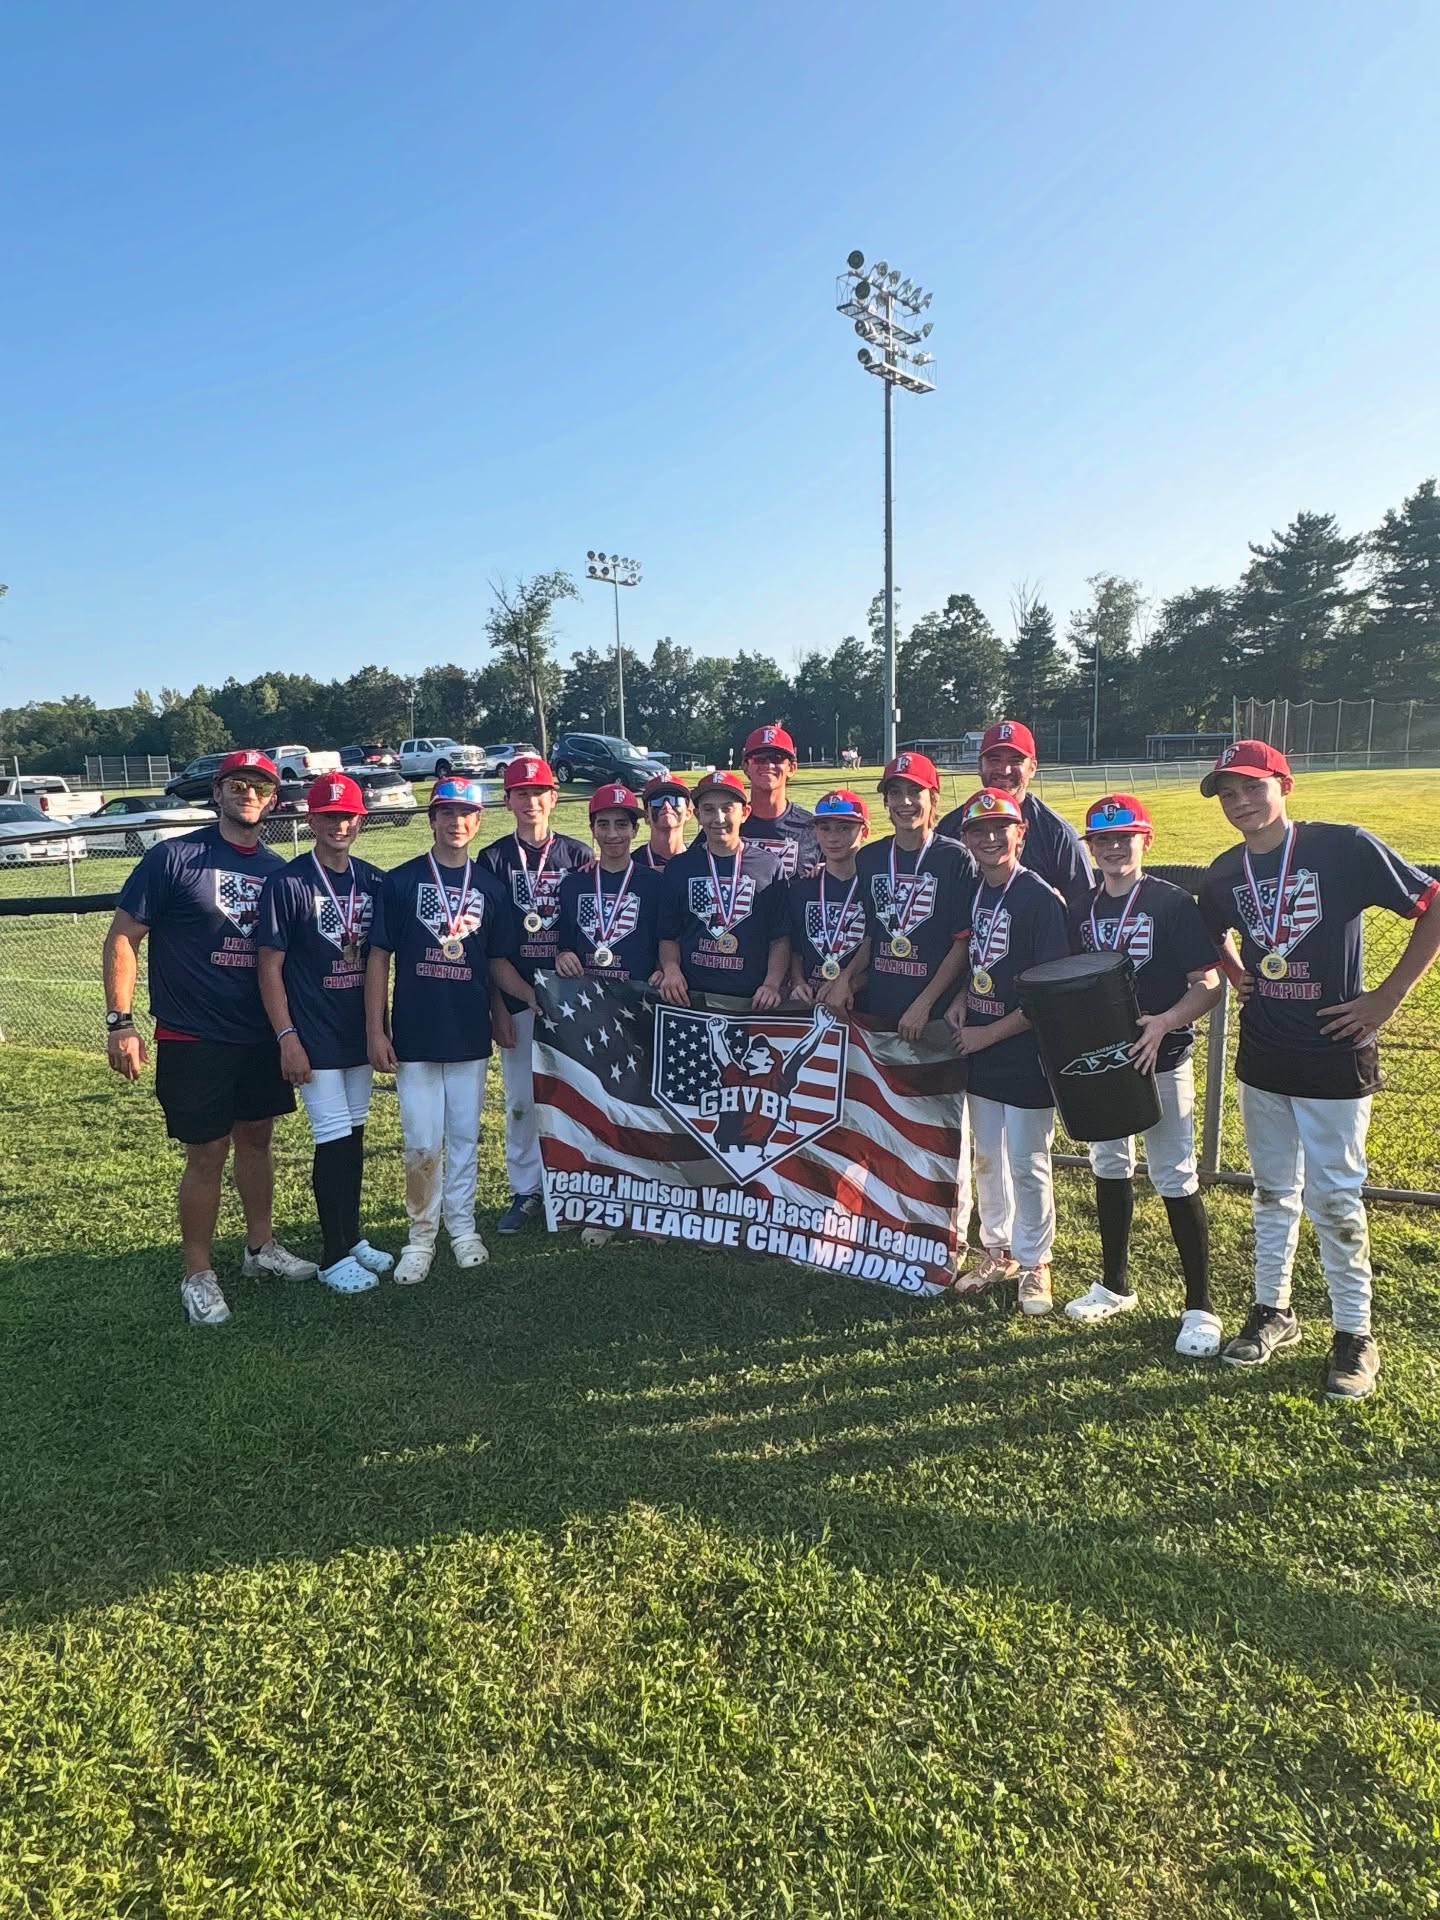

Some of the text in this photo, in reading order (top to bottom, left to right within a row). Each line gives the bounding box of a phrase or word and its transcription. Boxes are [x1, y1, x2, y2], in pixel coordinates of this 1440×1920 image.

[763, 730, 778, 744] F
[998, 725, 1015, 740] F
[246, 752, 260, 765] F
[895, 755, 912, 772] F
[524, 763, 538, 779] F
[330, 784, 345, 801] F
[613, 789, 626, 804] F
[690, 951, 744, 970] CHAMPIONS
[875, 956, 927, 976] CHAMPIONS
[416, 963, 472, 981] CHAMPIONS
[699, 1084, 797, 1131] GHVBL
[616, 1174, 698, 1209] Hudson
[702, 1186, 767, 1223] Valley
[770, 1196, 866, 1244] Baseball
[868, 1219, 949, 1266] League
[550, 1198, 927, 1292] 2025 LEAGUE CHAMPIONS
